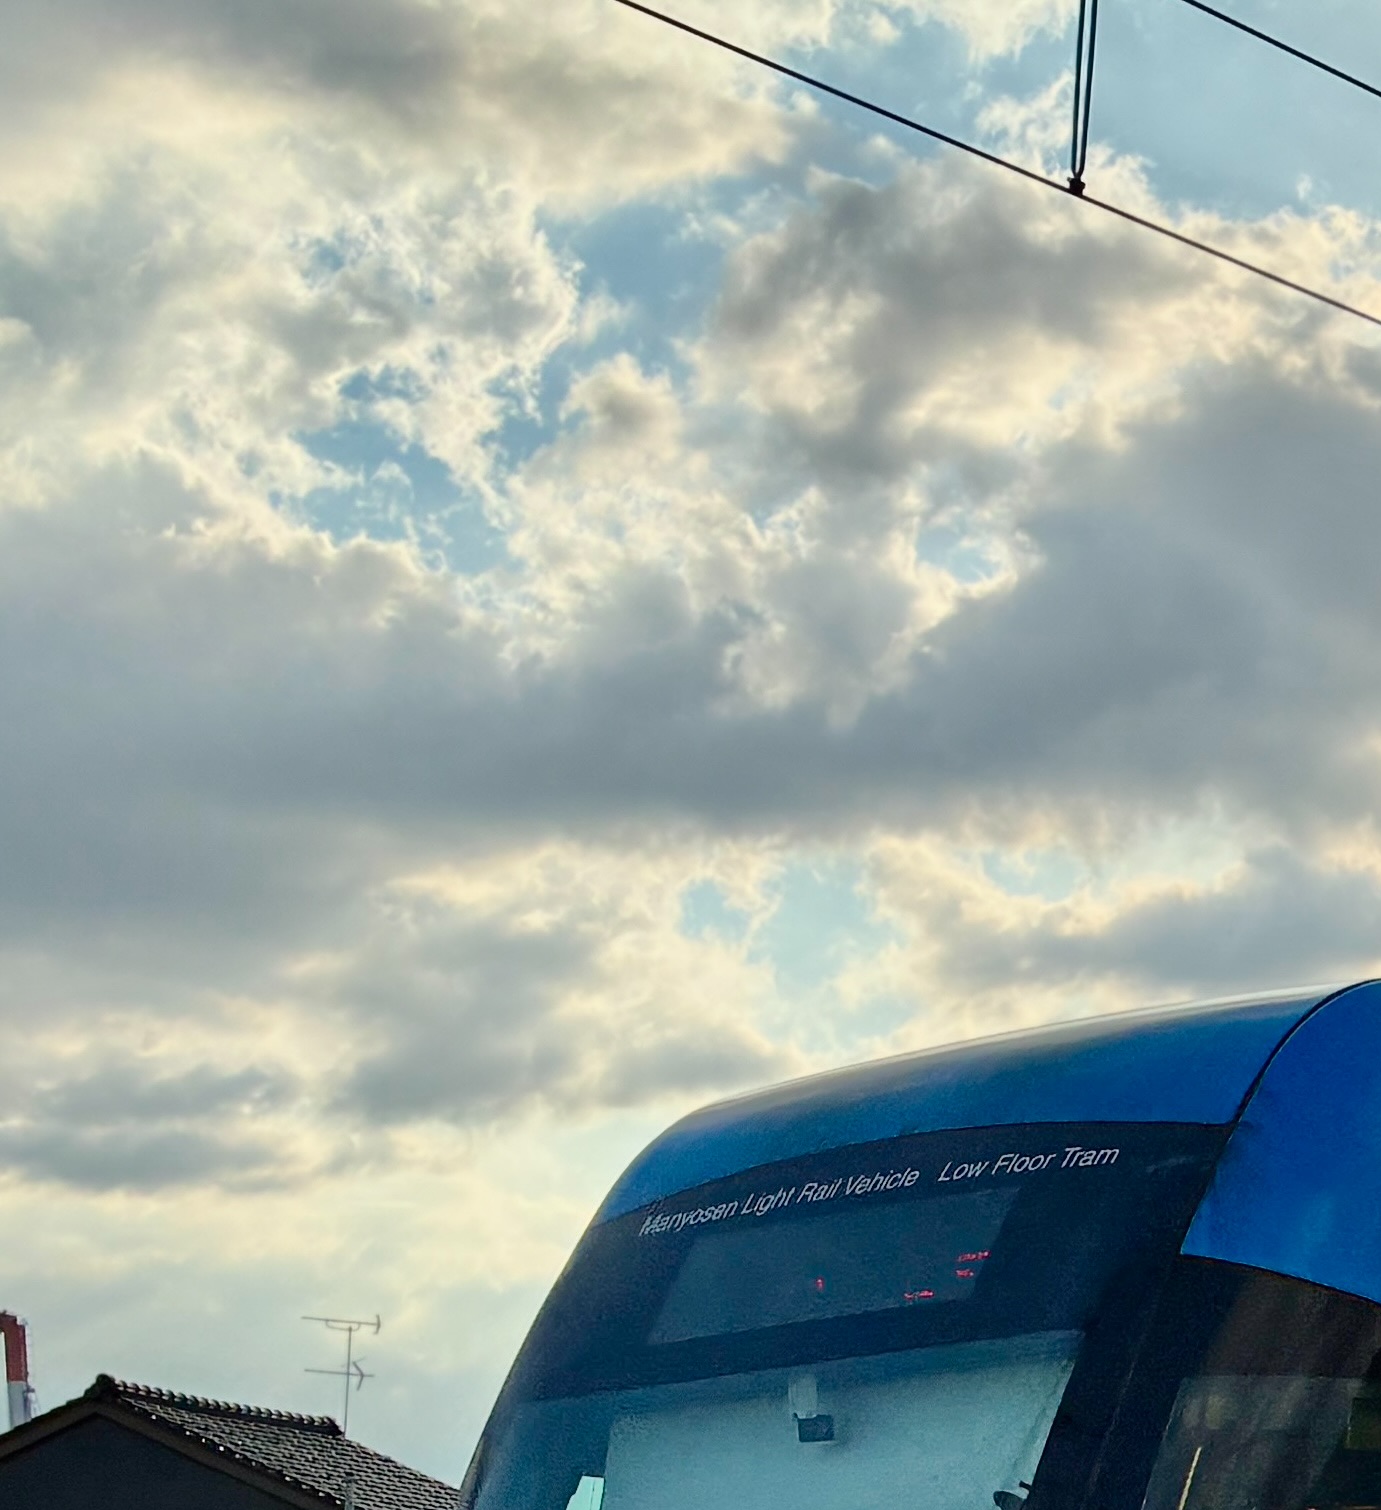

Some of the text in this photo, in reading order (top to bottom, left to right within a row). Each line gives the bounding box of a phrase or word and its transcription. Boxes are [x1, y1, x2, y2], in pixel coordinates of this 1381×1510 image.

[741, 1187, 796, 1216] Light
[797, 1179, 843, 1203] Rail
[845, 1166, 920, 1197] Vehicle
[937, 1160, 989, 1183] Low
[991, 1152, 1057, 1176] Floor
[1060, 1145, 1121, 1169] Tram
